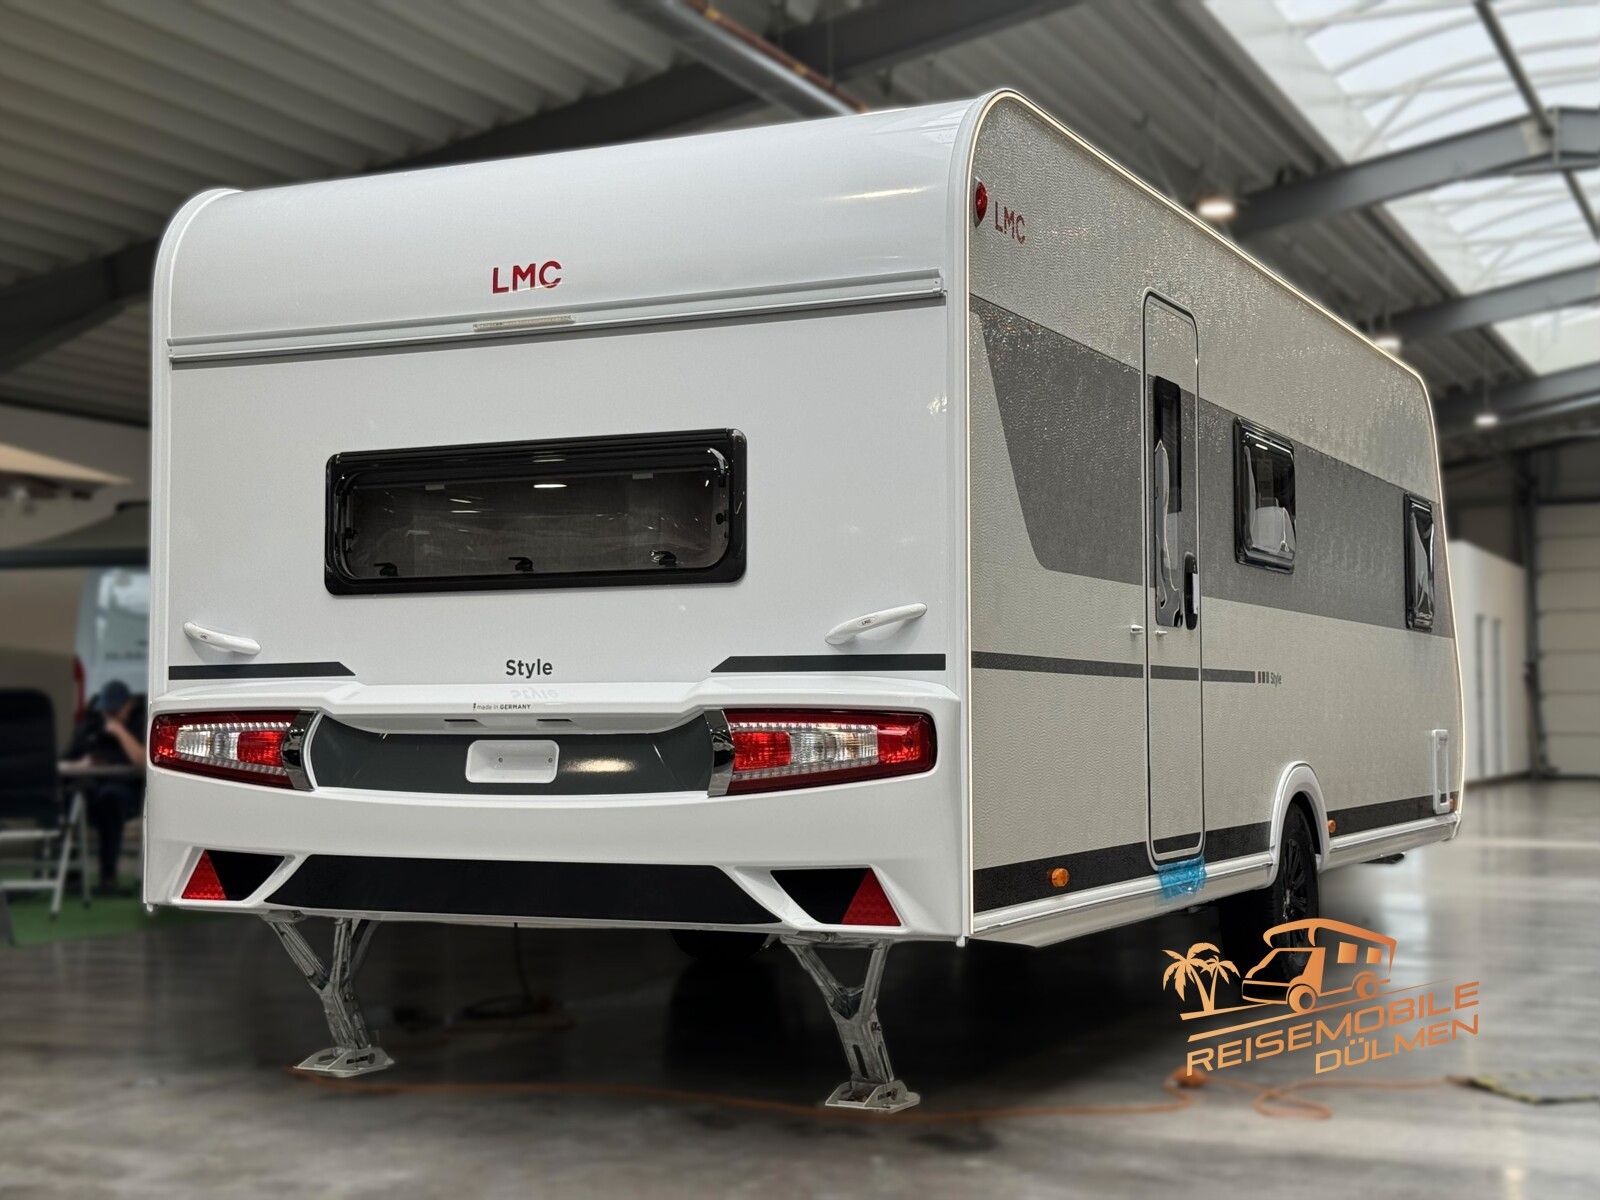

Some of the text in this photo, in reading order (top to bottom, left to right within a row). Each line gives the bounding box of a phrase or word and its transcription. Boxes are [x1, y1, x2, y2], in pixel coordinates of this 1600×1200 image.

[995, 201, 1026, 244] LMC
[492, 261, 562, 294] LMC
[505, 658, 553, 679] Style
